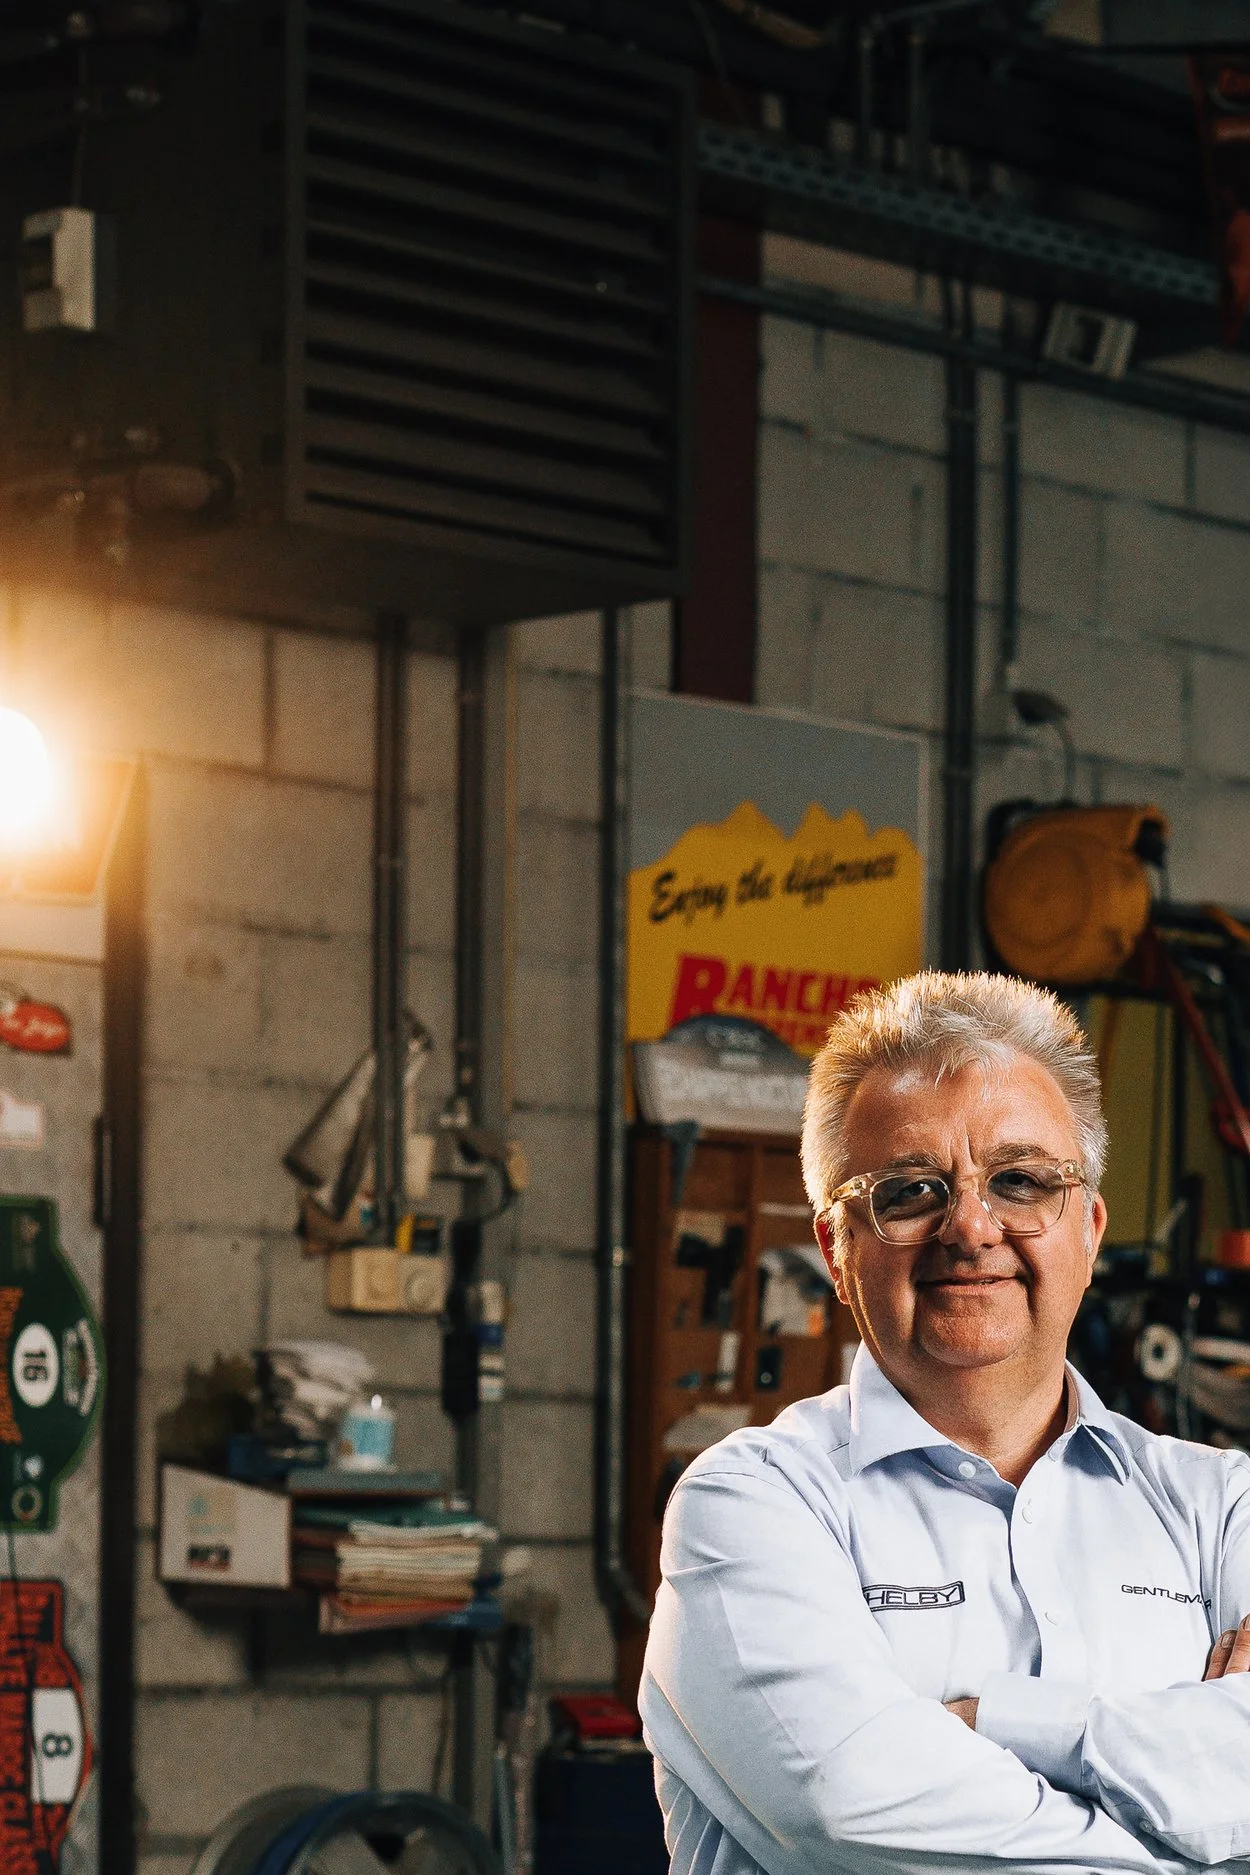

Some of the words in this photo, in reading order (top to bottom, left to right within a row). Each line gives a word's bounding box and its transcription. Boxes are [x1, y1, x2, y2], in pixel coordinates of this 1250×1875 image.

[650, 869, 728, 923] Enjoy
[736, 859, 774, 905] the
[783, 852, 900, 907] difference
[23, 1350, 49, 1383] 16
[865, 1586, 958, 1606] HELBY
[41, 1732, 74, 1759] 8
